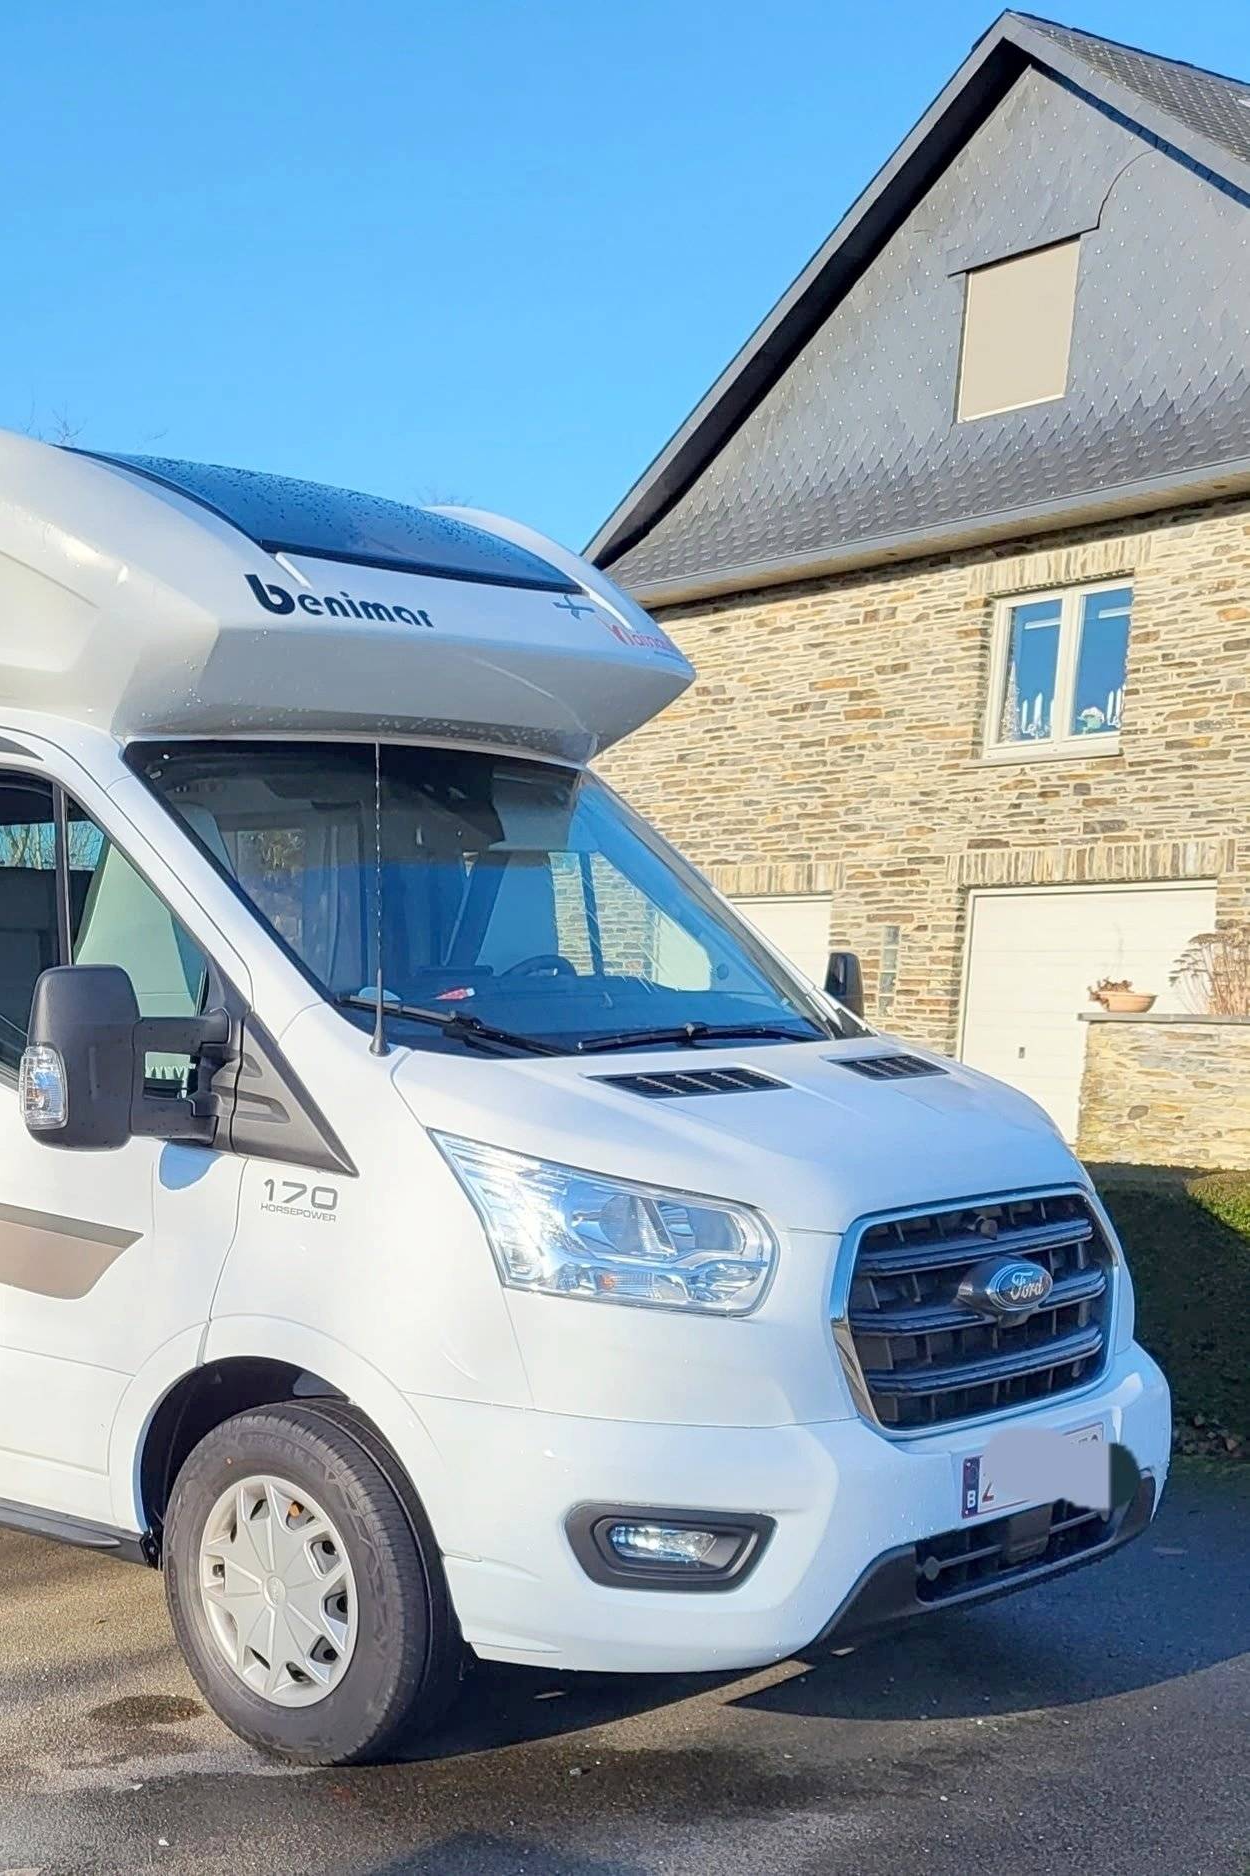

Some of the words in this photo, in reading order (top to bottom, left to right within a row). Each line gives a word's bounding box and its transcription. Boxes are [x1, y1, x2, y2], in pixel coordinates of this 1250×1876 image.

[244, 573, 435, 628] benimar
[263, 1178, 338, 1211] 170
[260, 1202, 338, 1223] HORSEPOWER
[1010, 1270, 1044, 1301] Ford
[966, 1489, 977, 1509] B
